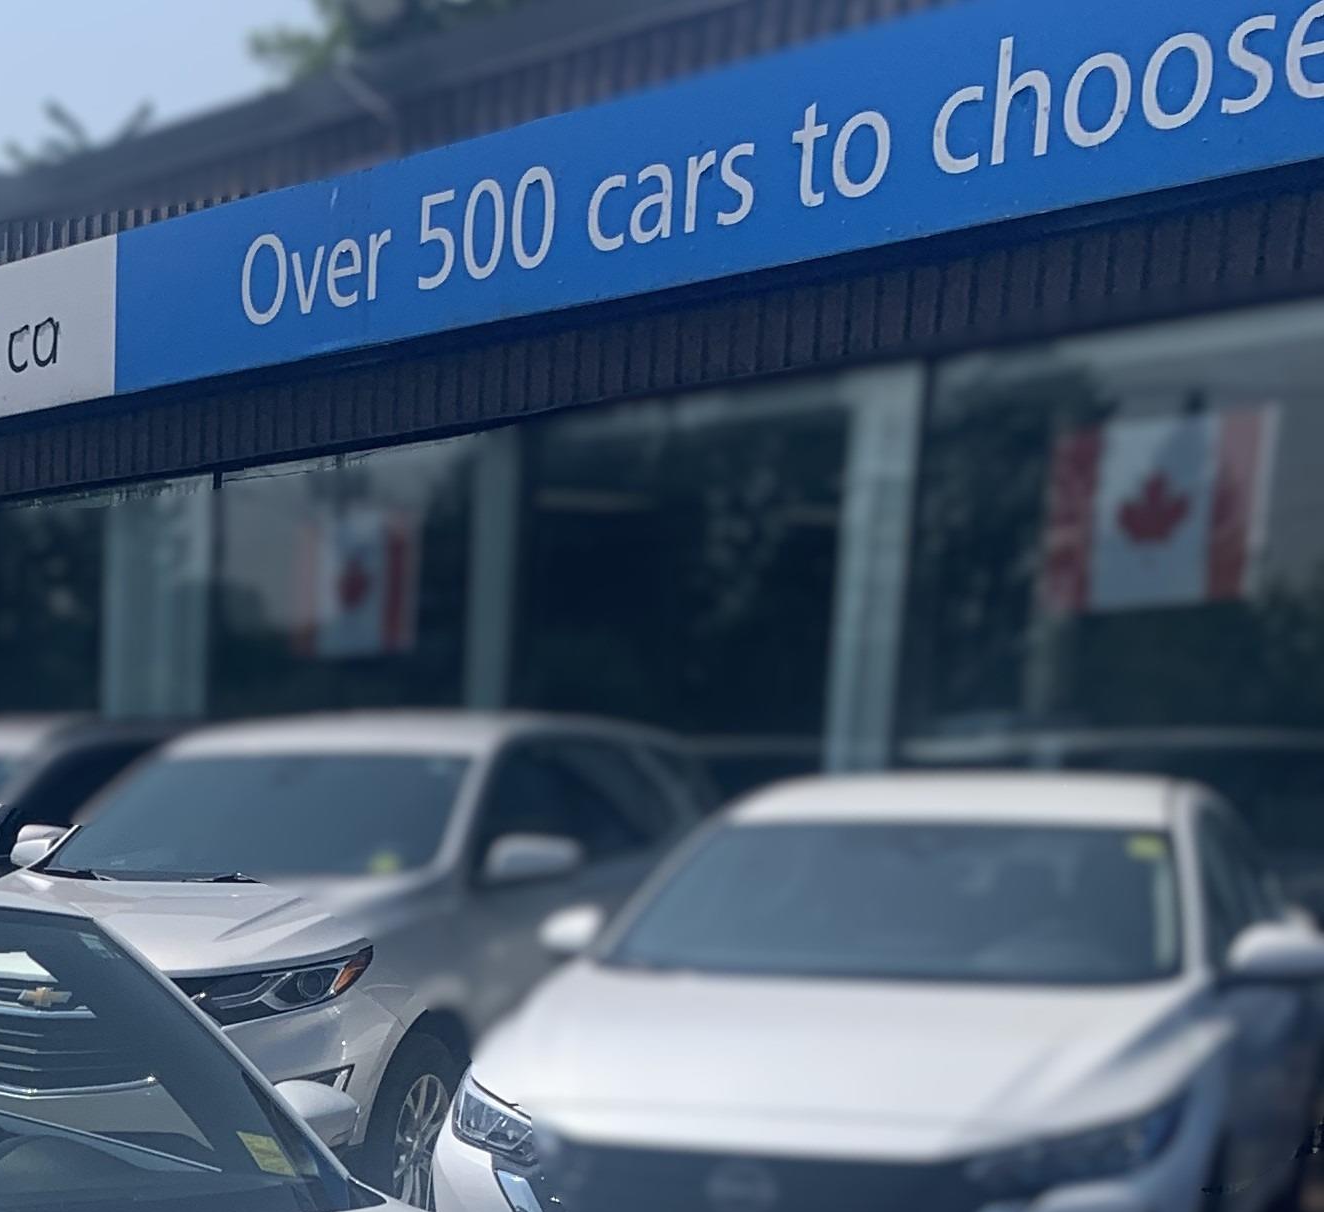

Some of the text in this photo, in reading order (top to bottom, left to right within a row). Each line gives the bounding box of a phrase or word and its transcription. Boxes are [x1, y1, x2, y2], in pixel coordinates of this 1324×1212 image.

[241, 229, 391, 325] Over
[418, 166, 555, 290] 500
[587, 143, 755, 251] cars
[792, 102, 891, 208] to
